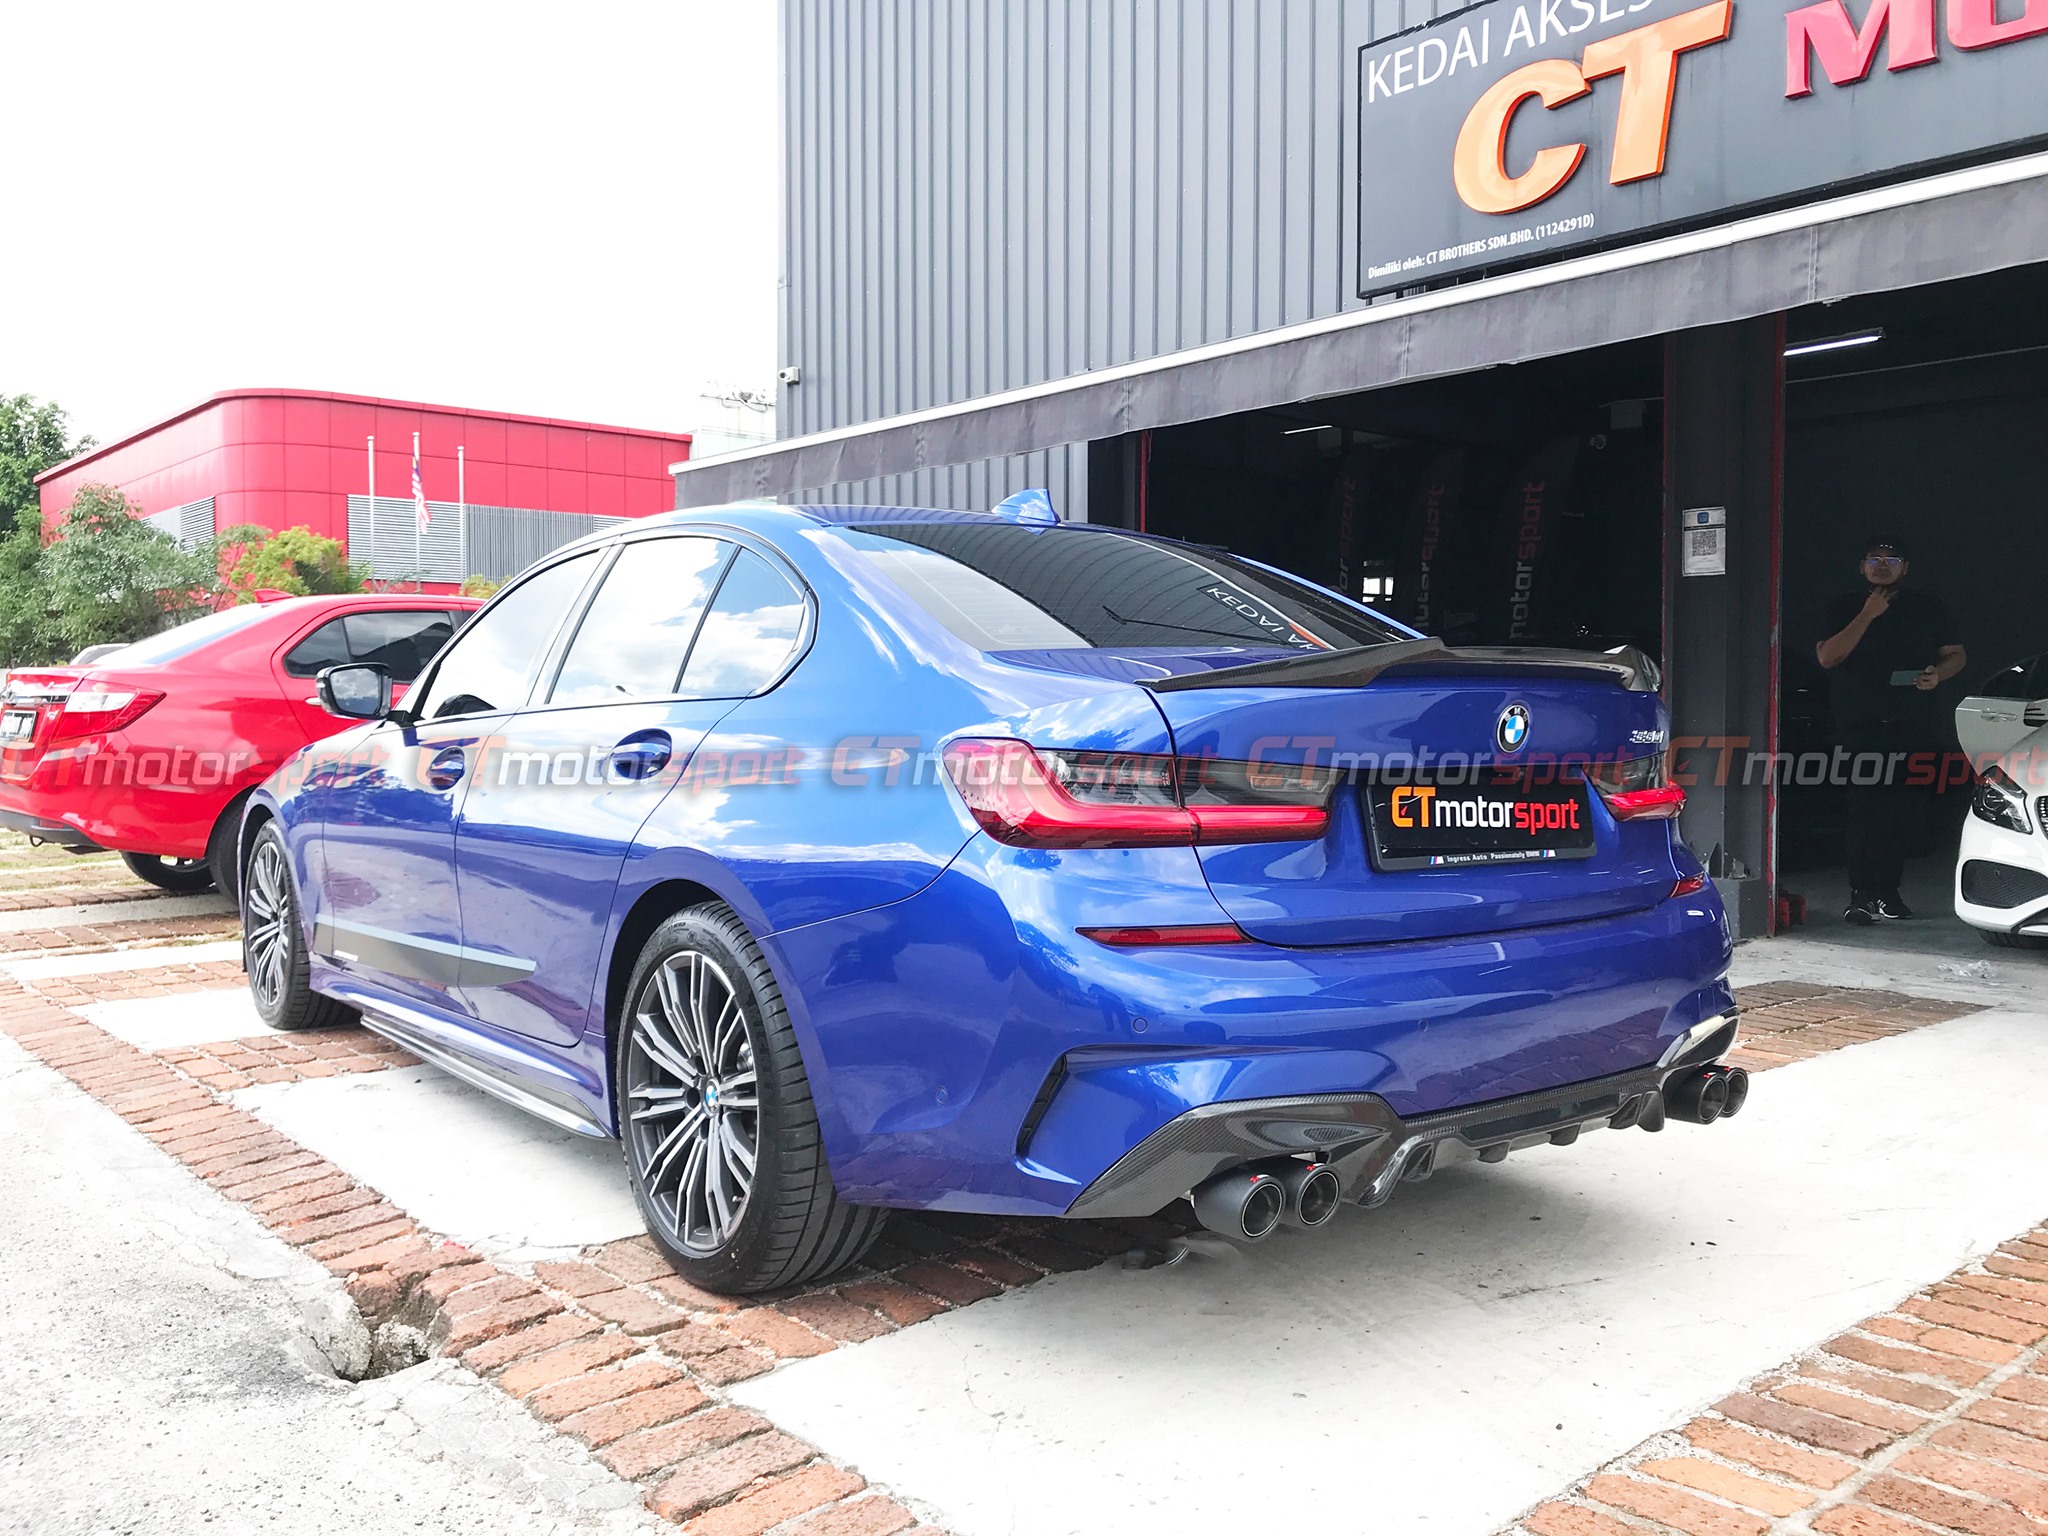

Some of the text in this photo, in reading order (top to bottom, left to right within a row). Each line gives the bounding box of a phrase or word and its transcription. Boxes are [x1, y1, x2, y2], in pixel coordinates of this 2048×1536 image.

[1368, 0, 1652, 103] KEDAI AKS
[1453, 0, 1734, 215] CT
[1368, 212, 1595, 279] Dimiliki oleh: CT BROTHERS SDN.BHD. (1124291D)
[1490, 851, 1525, 860] Passionately
